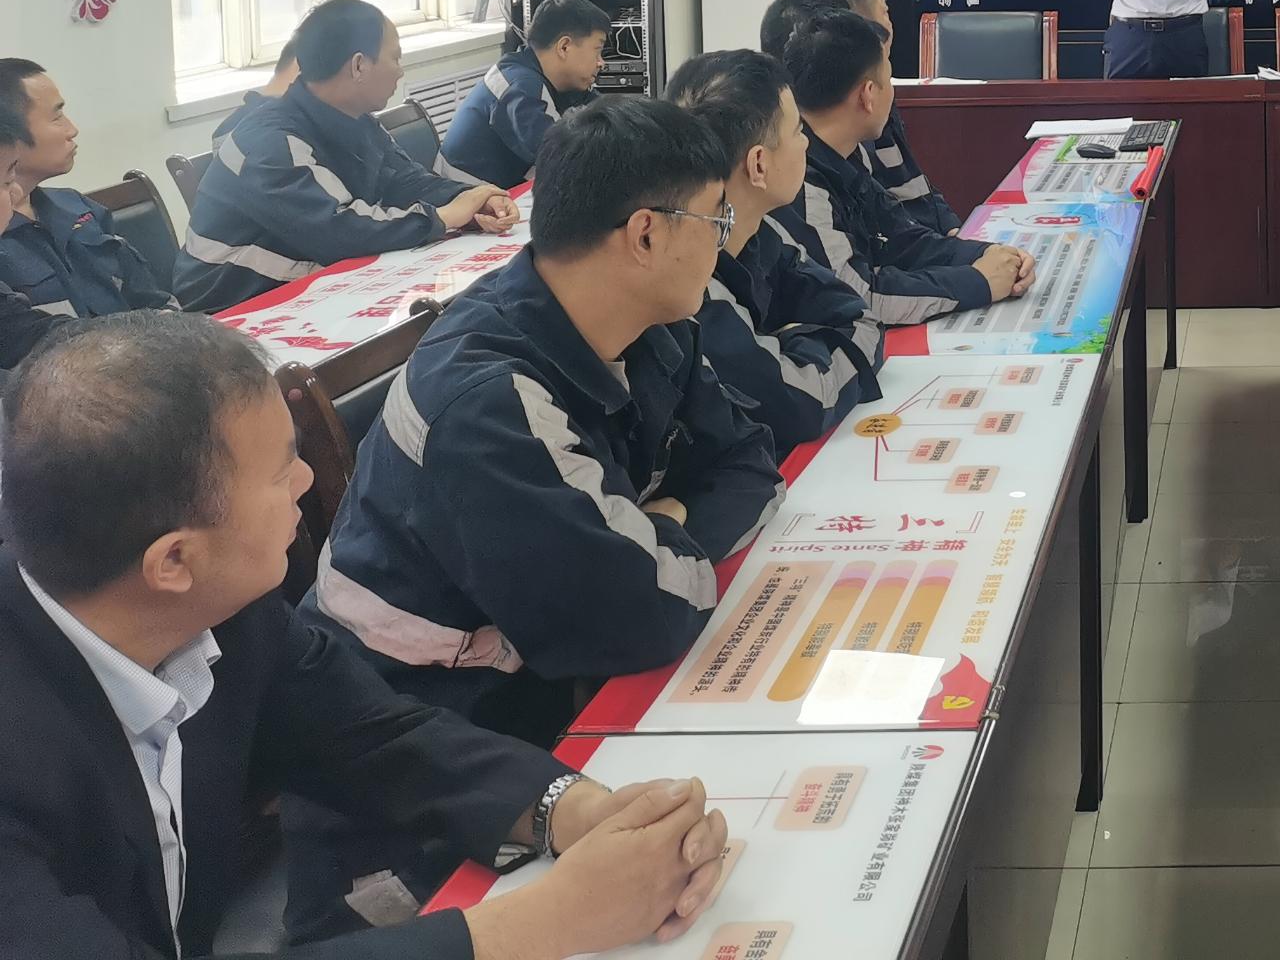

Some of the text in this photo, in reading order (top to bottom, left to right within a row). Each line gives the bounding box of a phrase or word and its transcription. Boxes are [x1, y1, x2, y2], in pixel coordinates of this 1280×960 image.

[766, 539, 968, 553] 精神 Sante Spirit
[989, 538, 1016, 567] 安全为天
